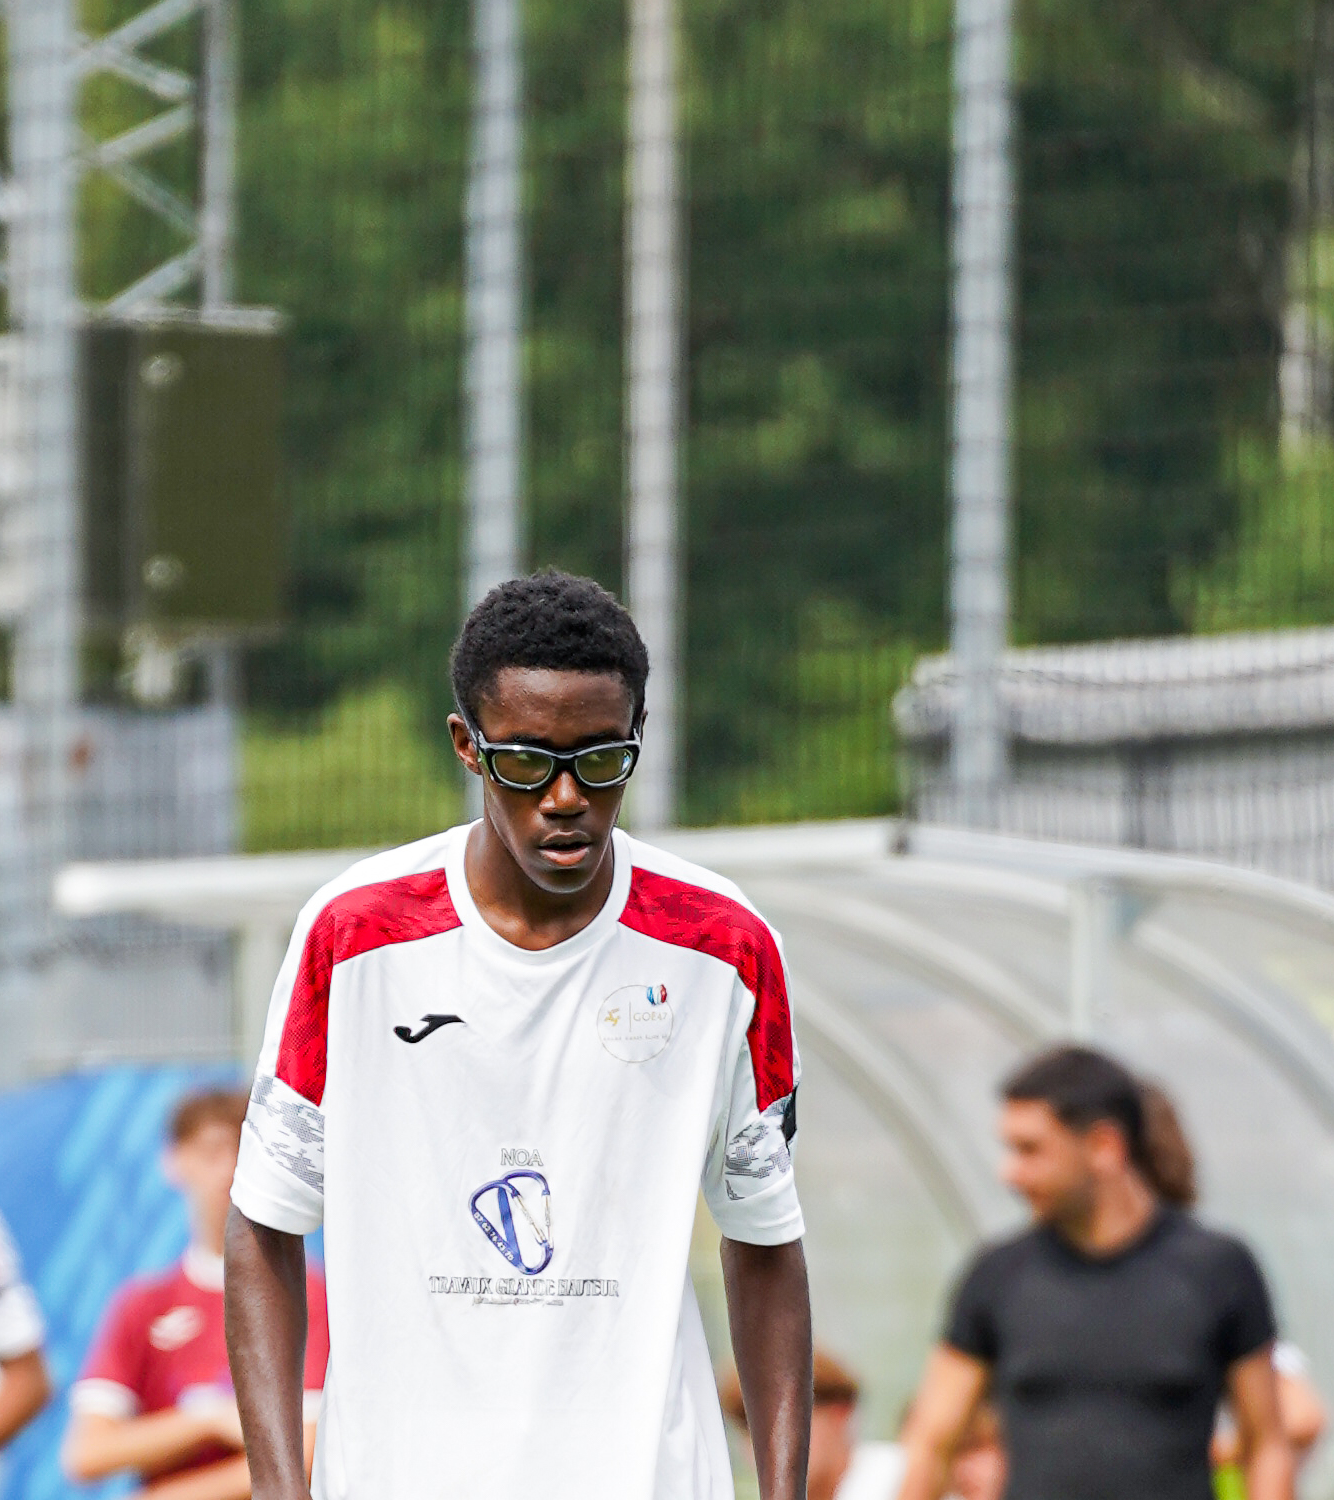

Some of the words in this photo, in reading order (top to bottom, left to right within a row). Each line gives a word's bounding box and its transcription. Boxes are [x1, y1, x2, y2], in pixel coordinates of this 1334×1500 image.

[500, 1148, 544, 1167] NOA
[429, 1276, 493, 1295] TRAVAUX
[496, 1278, 555, 1296] GRANDE
[557, 1279, 619, 1297] HAUTEUR
